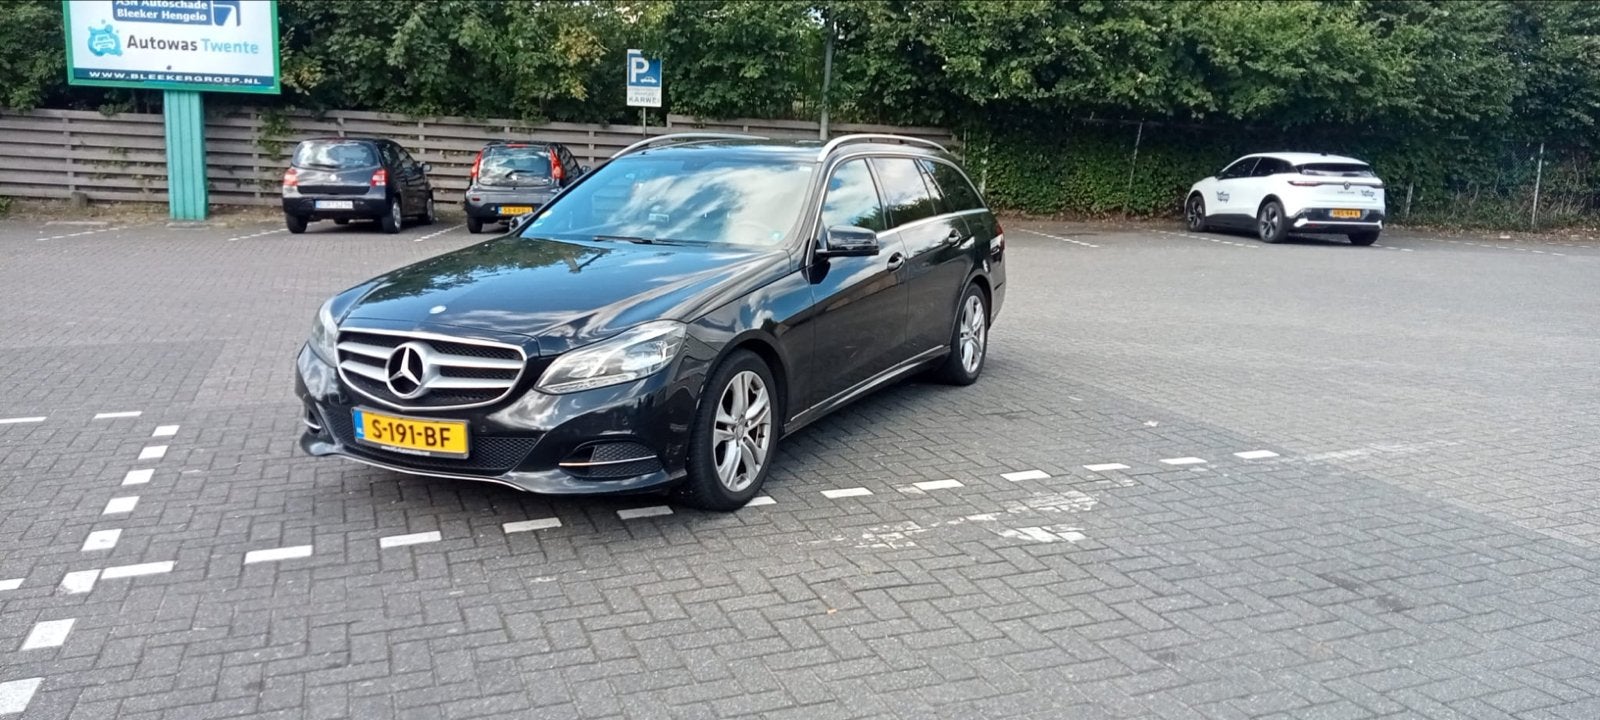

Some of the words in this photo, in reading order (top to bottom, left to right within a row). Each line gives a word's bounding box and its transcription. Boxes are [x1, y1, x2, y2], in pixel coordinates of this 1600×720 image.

[117, 8, 158, 18] Bleeker
[162, 10, 207, 22] Hengelo
[127, 35, 198, 51] Autowas
[201, 38, 259, 54] Twente
[89, 70, 261, 85] WWW.BLEEKERGROEP.NL
[631, 56, 650, 83] P
[372, 419, 451, 447] S-191-BF
